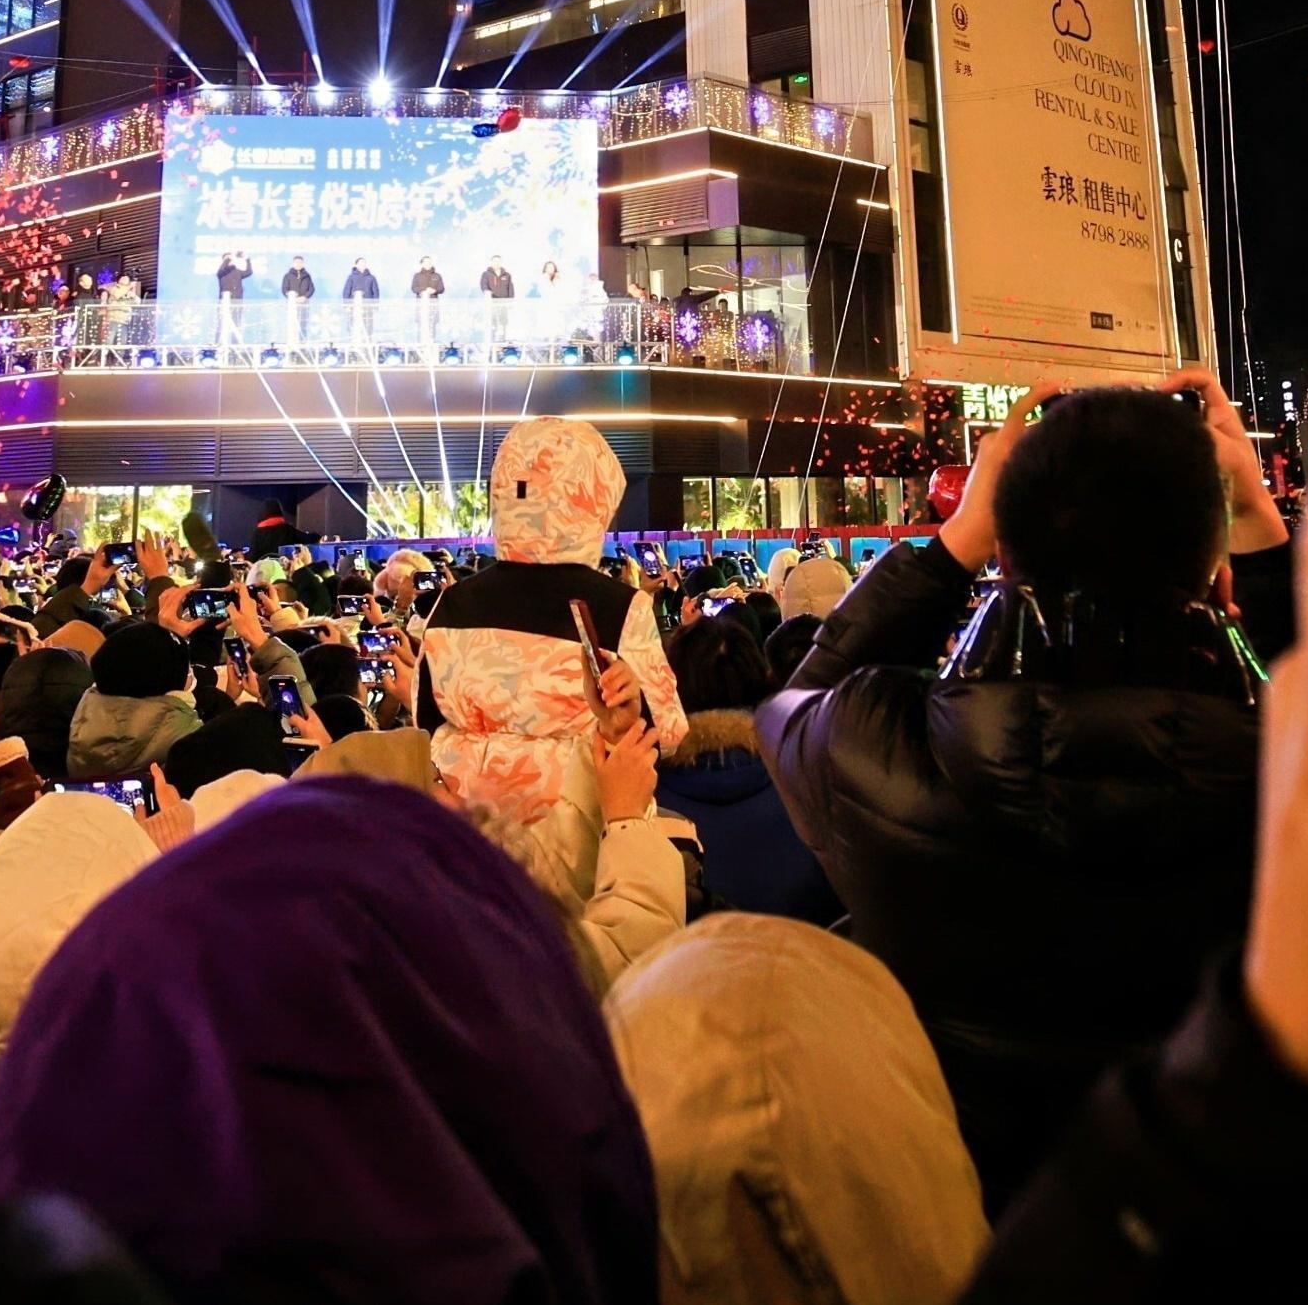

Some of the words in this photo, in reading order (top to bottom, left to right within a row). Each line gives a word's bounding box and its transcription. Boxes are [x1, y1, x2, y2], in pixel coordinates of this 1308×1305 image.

[1053, 38, 1134, 82] QINGYIFANG
[1074, 73, 1121, 104] CLOUD
[1035, 88, 1091, 123] RENTAL
[1094, 108, 1103, 125] &
[1106, 111, 1139, 137] SALE
[1088, 133, 1142, 164] CENTRE
[196, 176, 317, 230] 冰雪长春
[319, 179, 436, 235] 悦动跨年
[1082, 177, 1148, 221] 租售中心
[1081, 221, 1115, 244] 8798
[1118, 228, 1150, 251] 2888
